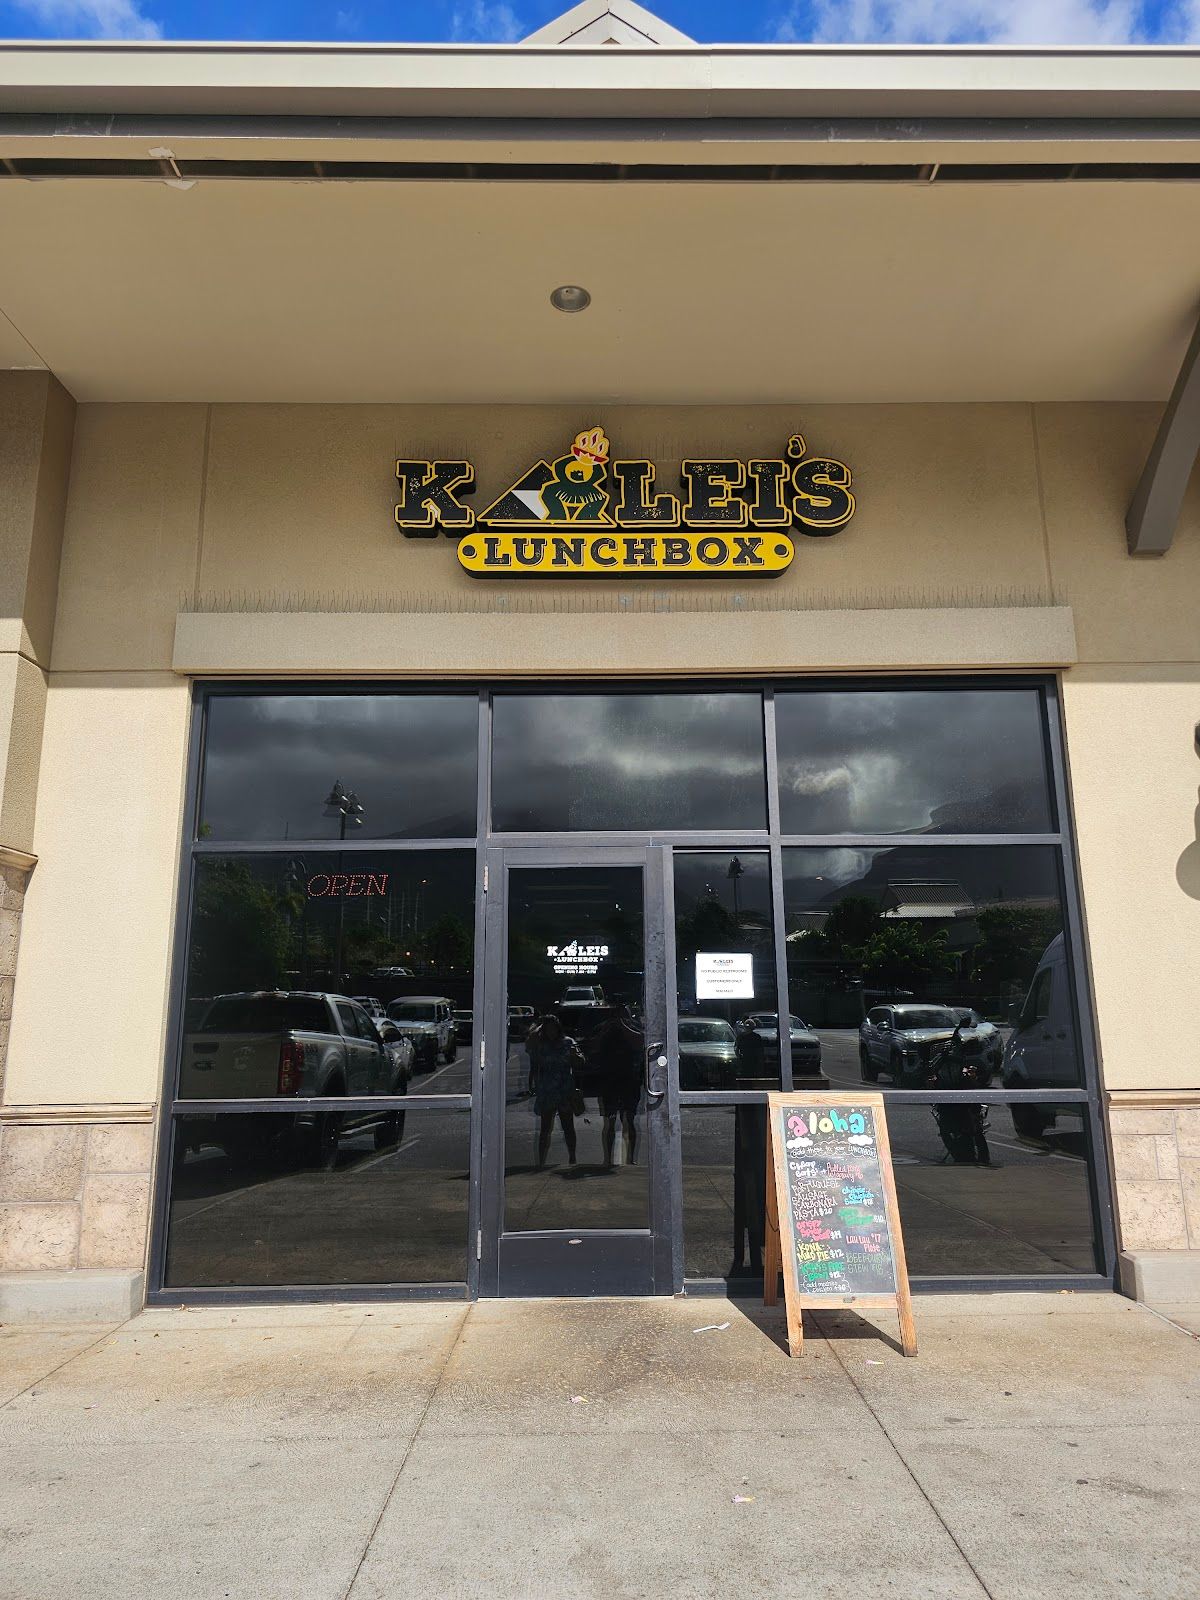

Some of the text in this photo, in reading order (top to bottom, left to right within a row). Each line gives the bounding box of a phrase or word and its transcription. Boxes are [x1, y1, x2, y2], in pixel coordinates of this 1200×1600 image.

[483, 537, 765, 567] LUNCHBOX
[307, 874, 389, 897] OPEN
[787, 1108, 865, 1137] aloha
[791, 1180, 841, 1195] PORTUGUESE
[791, 1190, 828, 1206] SAUSAGE
[793, 1206, 819, 1221] PASTA
